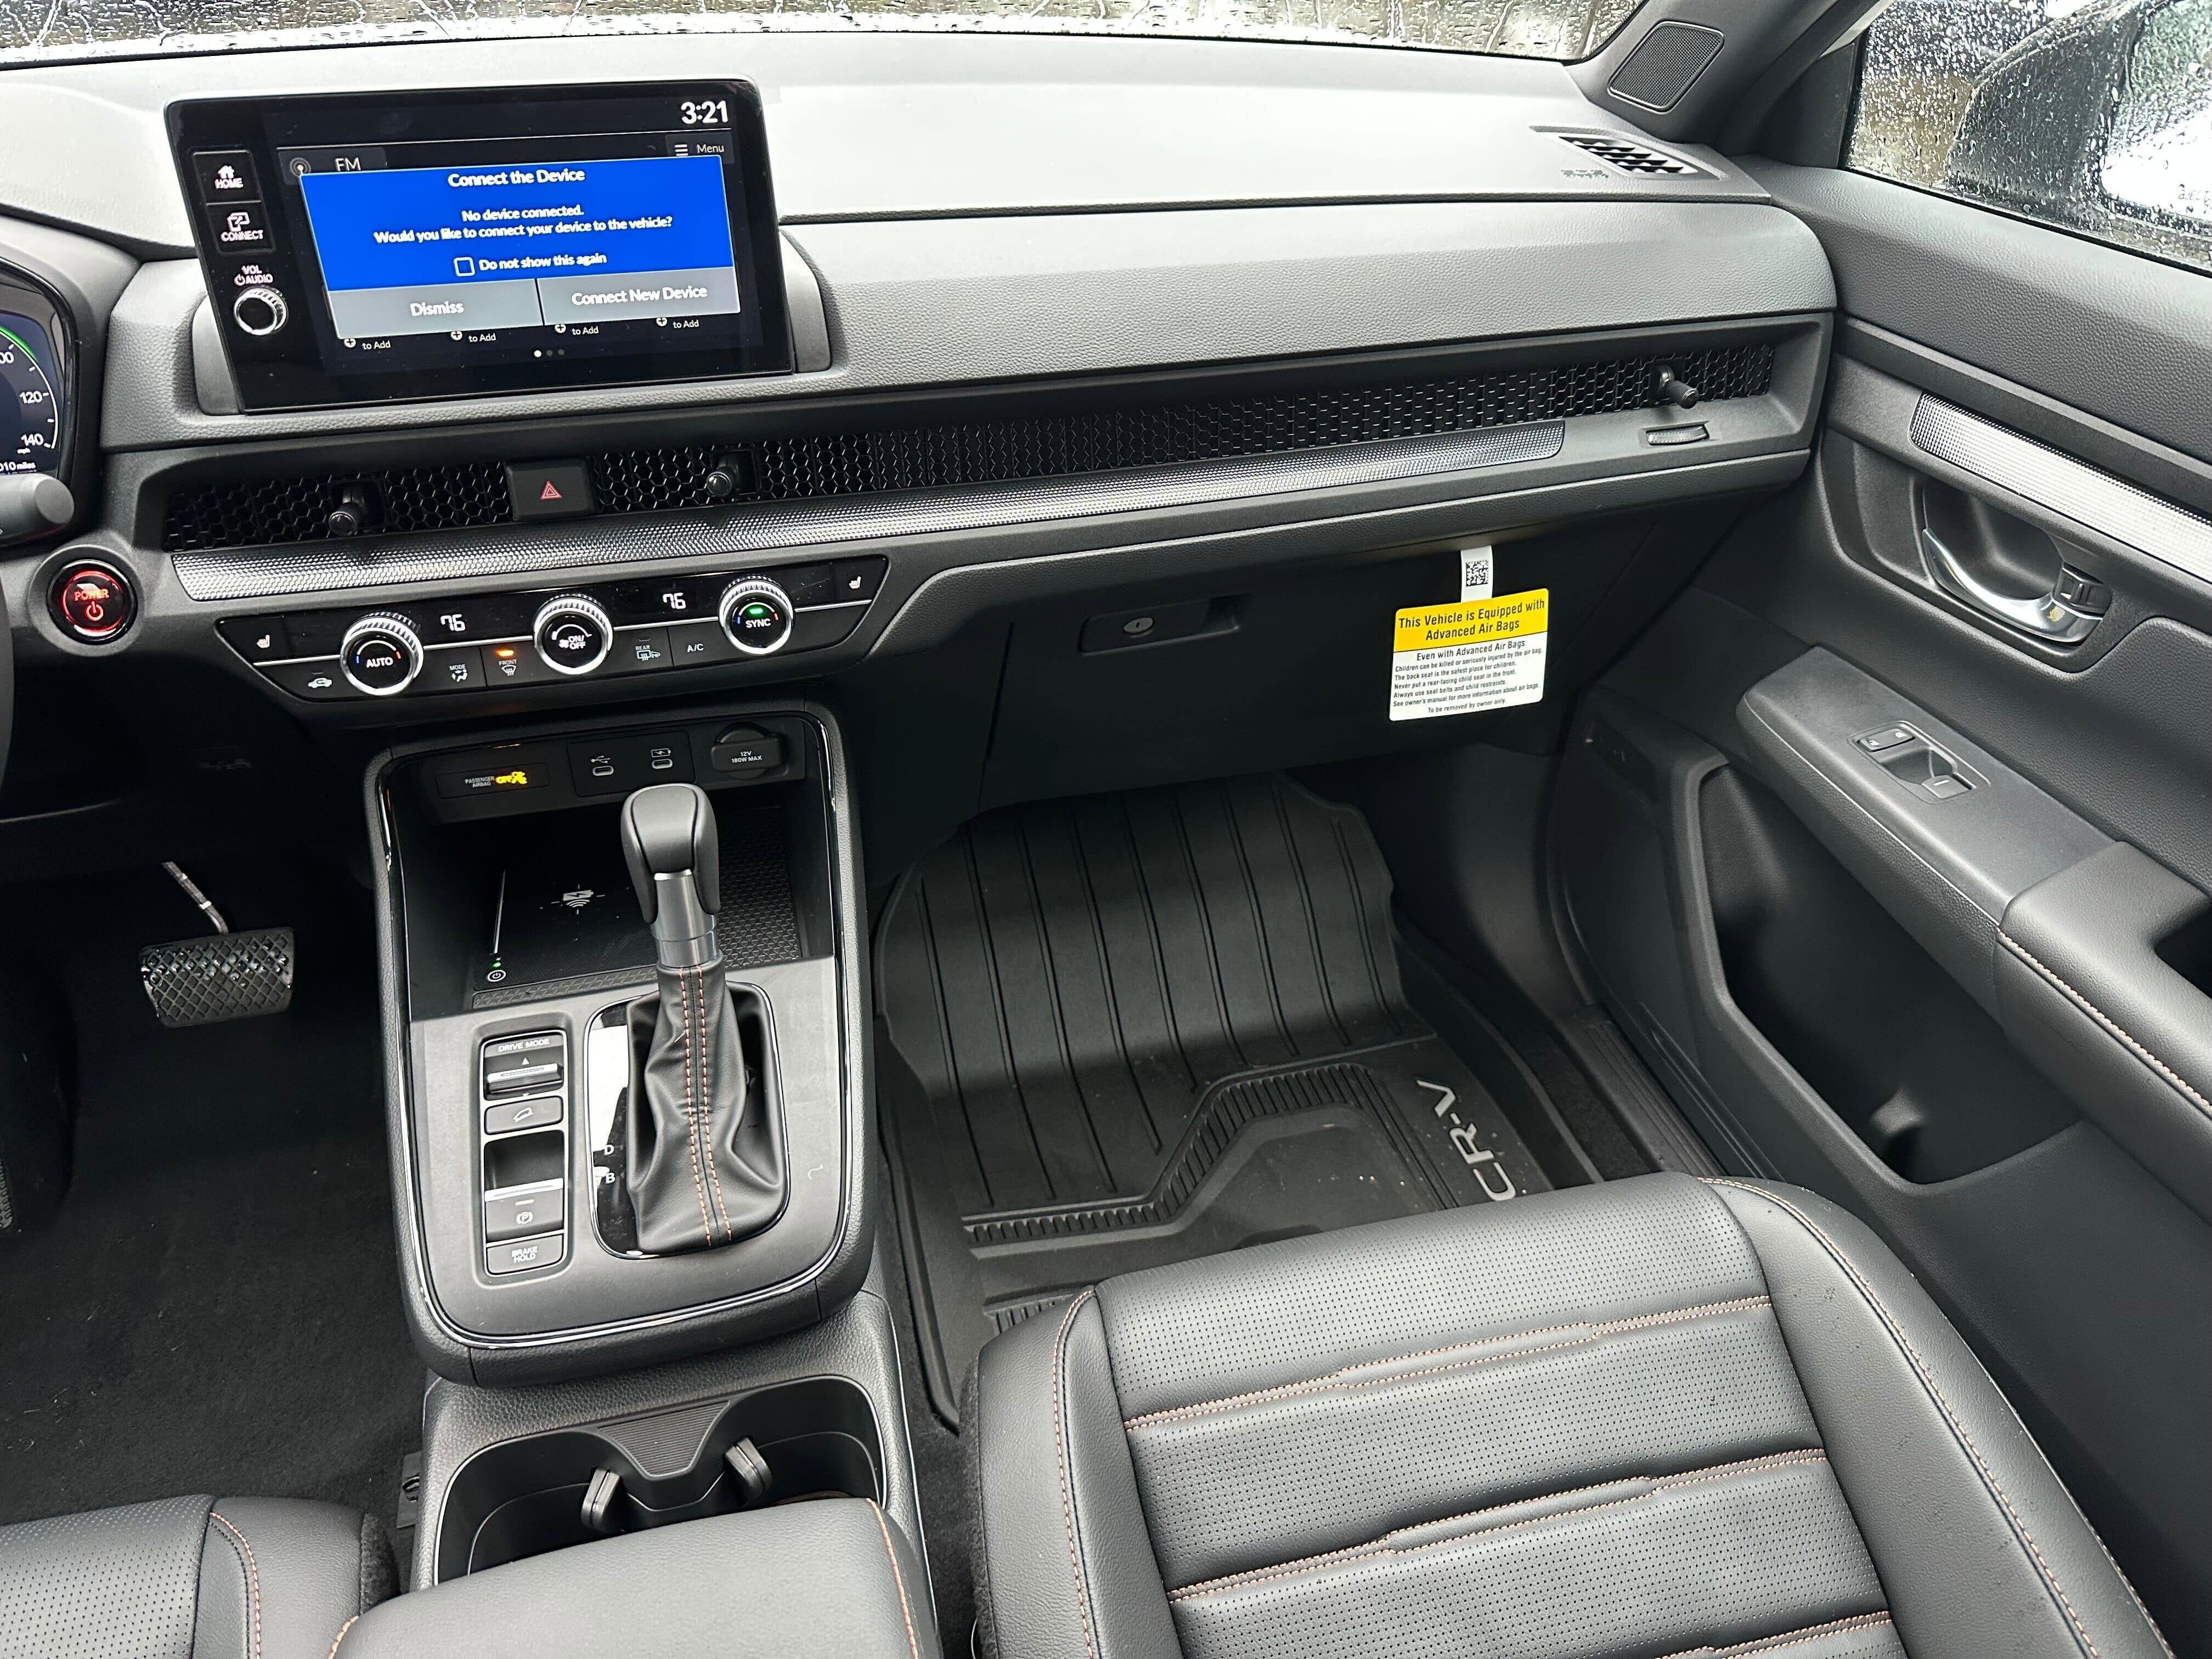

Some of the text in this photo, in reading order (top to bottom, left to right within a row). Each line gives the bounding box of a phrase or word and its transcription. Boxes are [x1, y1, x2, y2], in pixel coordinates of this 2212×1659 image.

[680, 100, 729, 124] 3:21
[697, 143, 725, 154] Menu
[335, 157, 362, 171] FM
[215, 177, 244, 189] HOME
[448, 168, 586, 188] Connect the Device
[461, 204, 585, 222] No device connected.
[221, 229, 264, 242] CONNECT
[373, 216, 673, 244] Would you like to connect your device to the vehicle?
[478, 252, 608, 271] Do not show this again
[241, 265, 262, 274] VOL
[245, 274, 273, 284] AUDIO
[572, 285, 708, 306] Connect New Device
[410, 301, 465, 317] Dismiss
[683, 319, 699, 328] Add
[572, 326, 599, 336] to Add
[479, 333, 496, 342] Add
[373, 340, 391, 349] Add
[19, 391, 43, 404] 120
[21, 433, 44, 446] 140
[74, 588, 109, 601] POWER
[663, 592, 686, 609] 76
[1398, 599, 1545, 629] This Vehicle is Equipped with
[440, 614, 466, 631] 76
[746, 618, 771, 629] SYNC
[1425, 619, 1520, 641] Advanced Air Bags
[568, 635, 584, 643] ON/
[569, 641, 586, 650] OFF
[687, 644, 704, 652] A/C
[1437, 650, 1454, 658] with
[1456, 644, 1493, 656] Advanced
[1508, 640, 1525, 649] Bags
[366, 657, 394, 668] AUTO
[1469, 665, 1483, 674] place
[1427, 678, 1457, 686] rear-facing
[1472, 689, 1502, 698] information
[1444, 703, 1467, 711] removed
[465, 776, 494, 784] PASSENGER
[498, 1038, 550, 1052] DRIVE MODE
[1416, 1079, 1516, 1201] CR-V
[604, 1144, 614, 1155] D
[605, 1172, 616, 1184] B
[511, 1246, 538, 1257] BRAKE
[514, 1252, 536, 1263] HOLD
